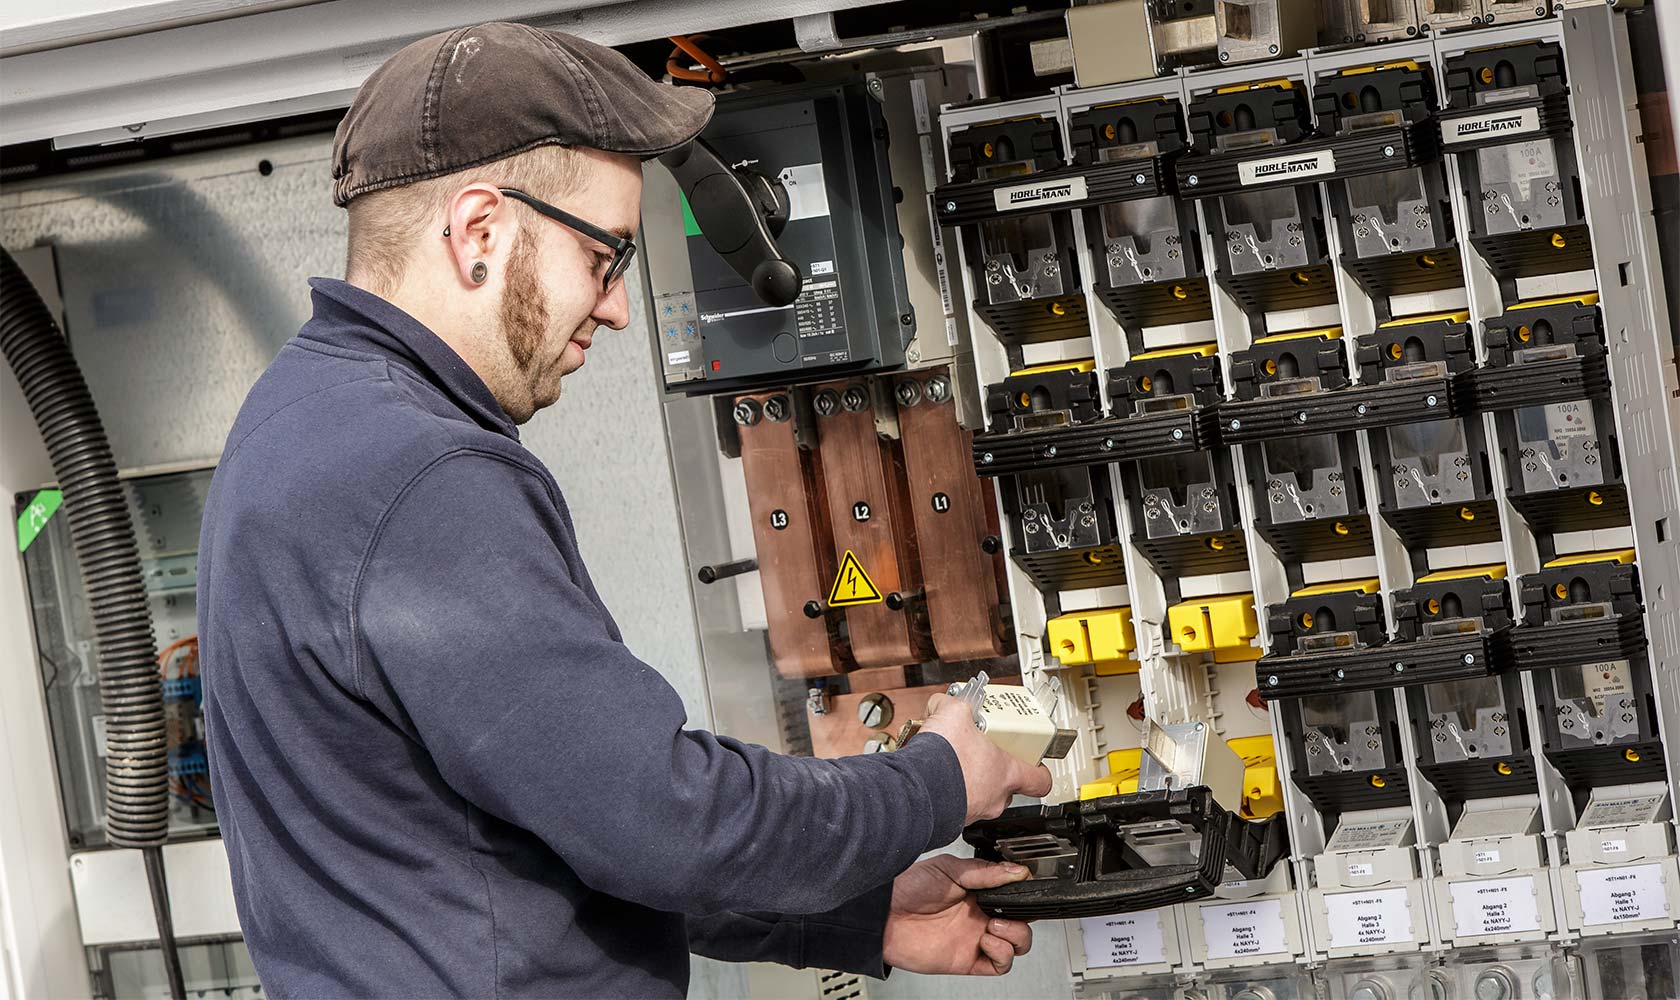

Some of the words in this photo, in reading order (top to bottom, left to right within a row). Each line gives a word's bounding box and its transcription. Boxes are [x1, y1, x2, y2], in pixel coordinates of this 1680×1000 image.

[1458, 120, 1522, 132] HORLEMANN
[1255, 162, 1318, 174] HORLEMANN
[1010, 188, 1071, 200] HORLEMANN
[701, 312, 723, 321] Schneider
[934, 496, 947, 510] L1
[854, 506, 870, 520] L2
[772, 513, 786, 526] L3
